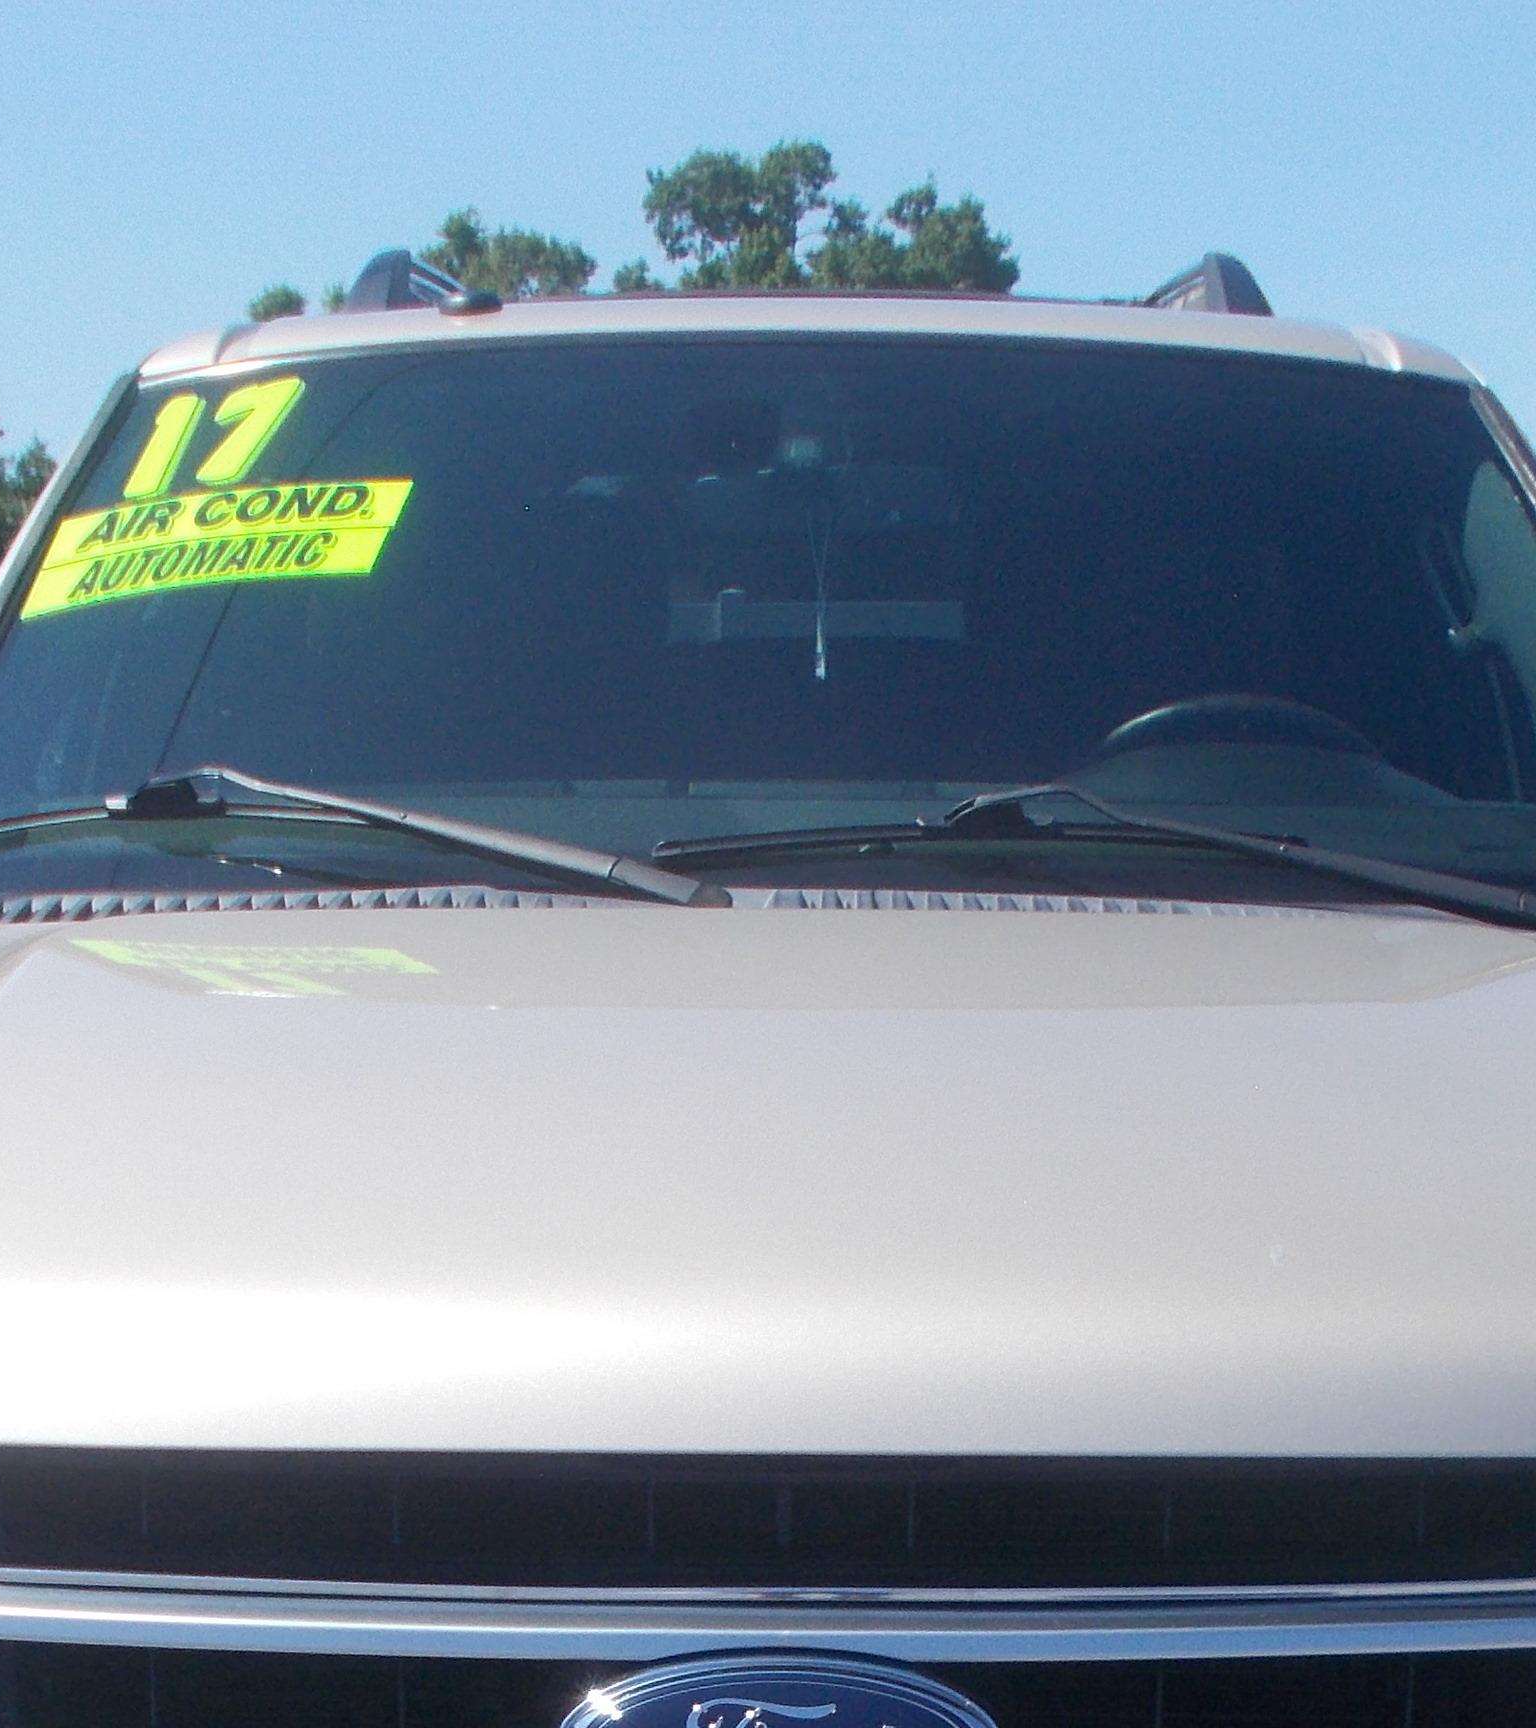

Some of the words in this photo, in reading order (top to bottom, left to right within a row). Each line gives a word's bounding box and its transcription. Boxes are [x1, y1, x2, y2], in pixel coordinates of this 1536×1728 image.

[124, 376, 306, 500] 17
[76, 500, 184, 554] AIR
[67, 528, 339, 603] AUTOMATIC
